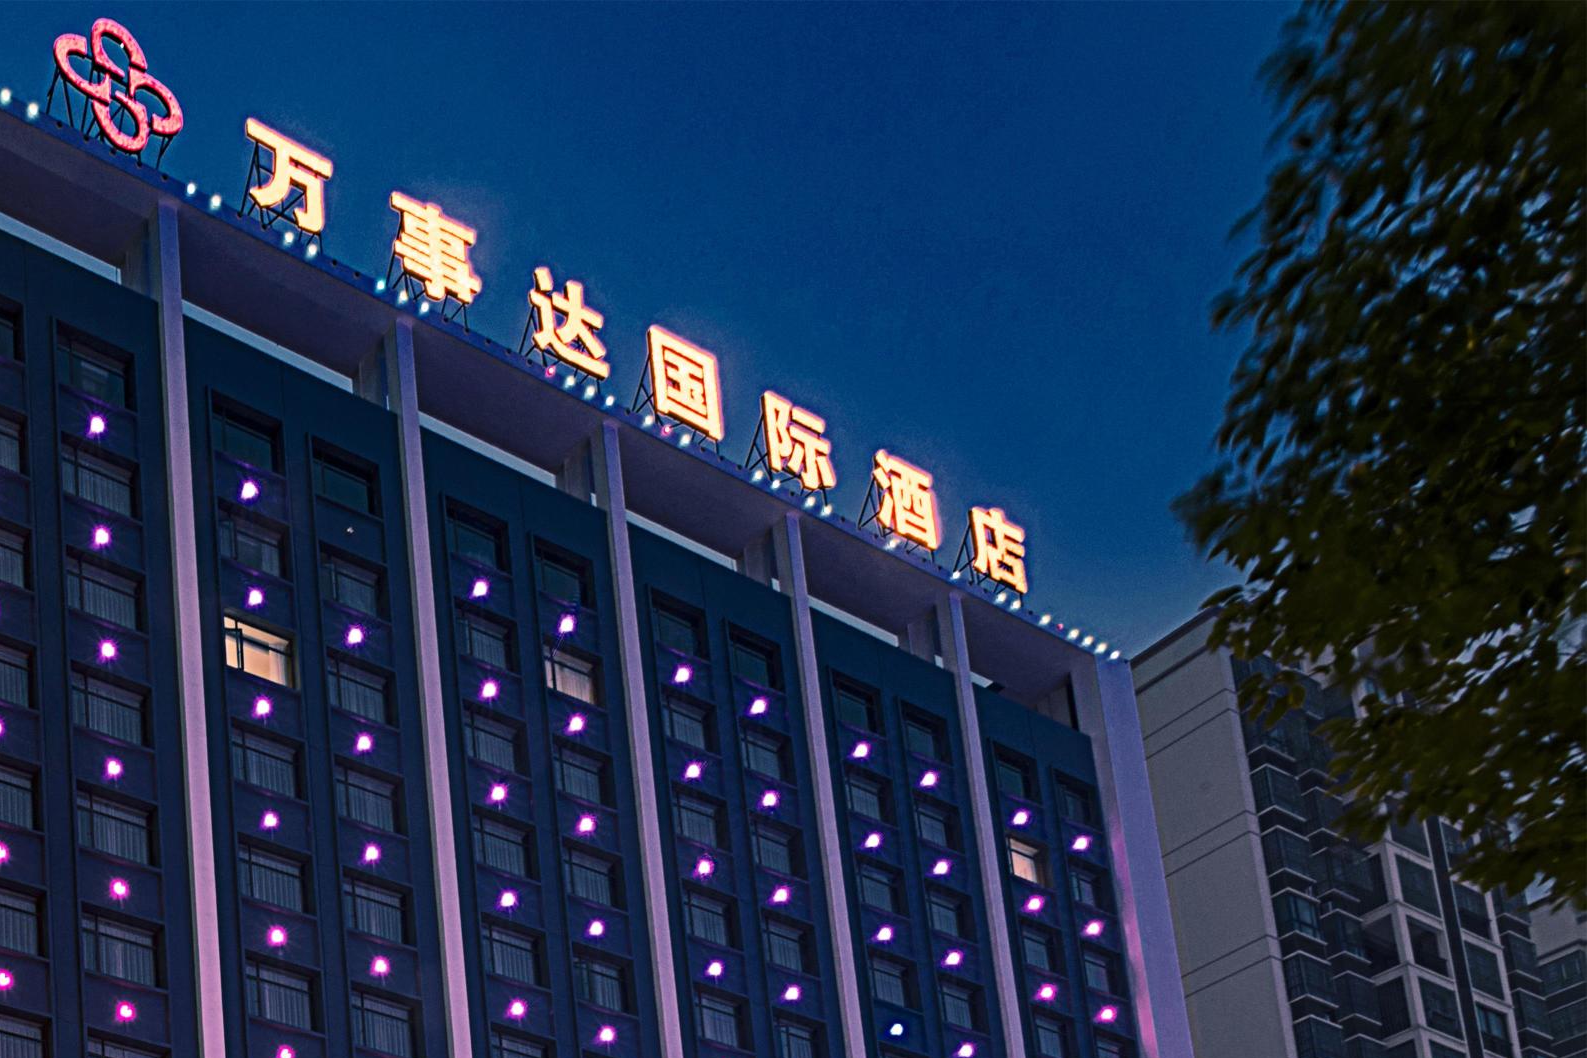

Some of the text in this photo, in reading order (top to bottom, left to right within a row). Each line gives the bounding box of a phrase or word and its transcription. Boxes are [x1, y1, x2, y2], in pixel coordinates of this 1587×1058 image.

[245, 117, 1029, 596] 万事达国际酒店
